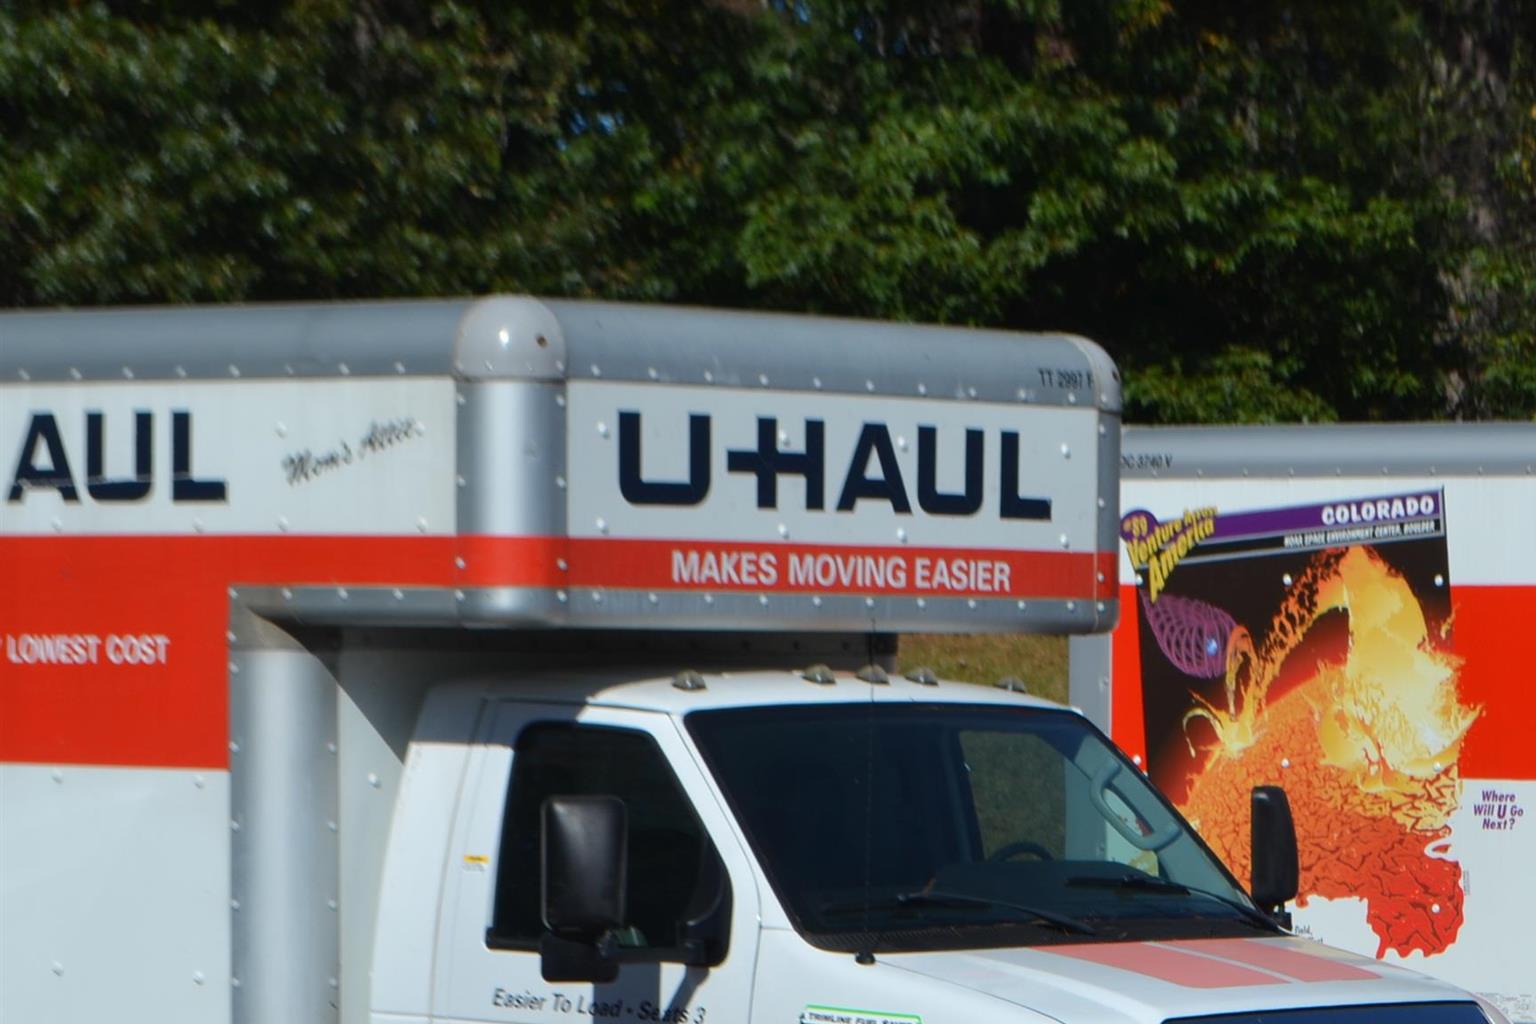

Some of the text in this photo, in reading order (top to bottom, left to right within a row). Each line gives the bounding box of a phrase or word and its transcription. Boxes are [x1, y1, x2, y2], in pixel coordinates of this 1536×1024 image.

[7, 411, 228, 503] AUL
[618, 410, 1053, 521] U-HAUL
[1321, 495, 1435, 526] COLORADO
[1126, 519, 1183, 570] Venture
[1148, 518, 1215, 605] America
[671, 549, 1012, 592] MAKES MOVING EASIER
[6, 633, 171, 665] LOWEST COST
[1473, 803, 1524, 820] Will U Go
[1482, 789, 1516, 803] Where
[1482, 817, 1516, 831] Next?
[493, 988, 547, 1011] Easier
[552, 992, 573, 1013] To
[576, 995, 622, 1018] Load
[636, 1001, 689, 1024] Seats
[808, 1011, 853, 1024] TRIMLINE
